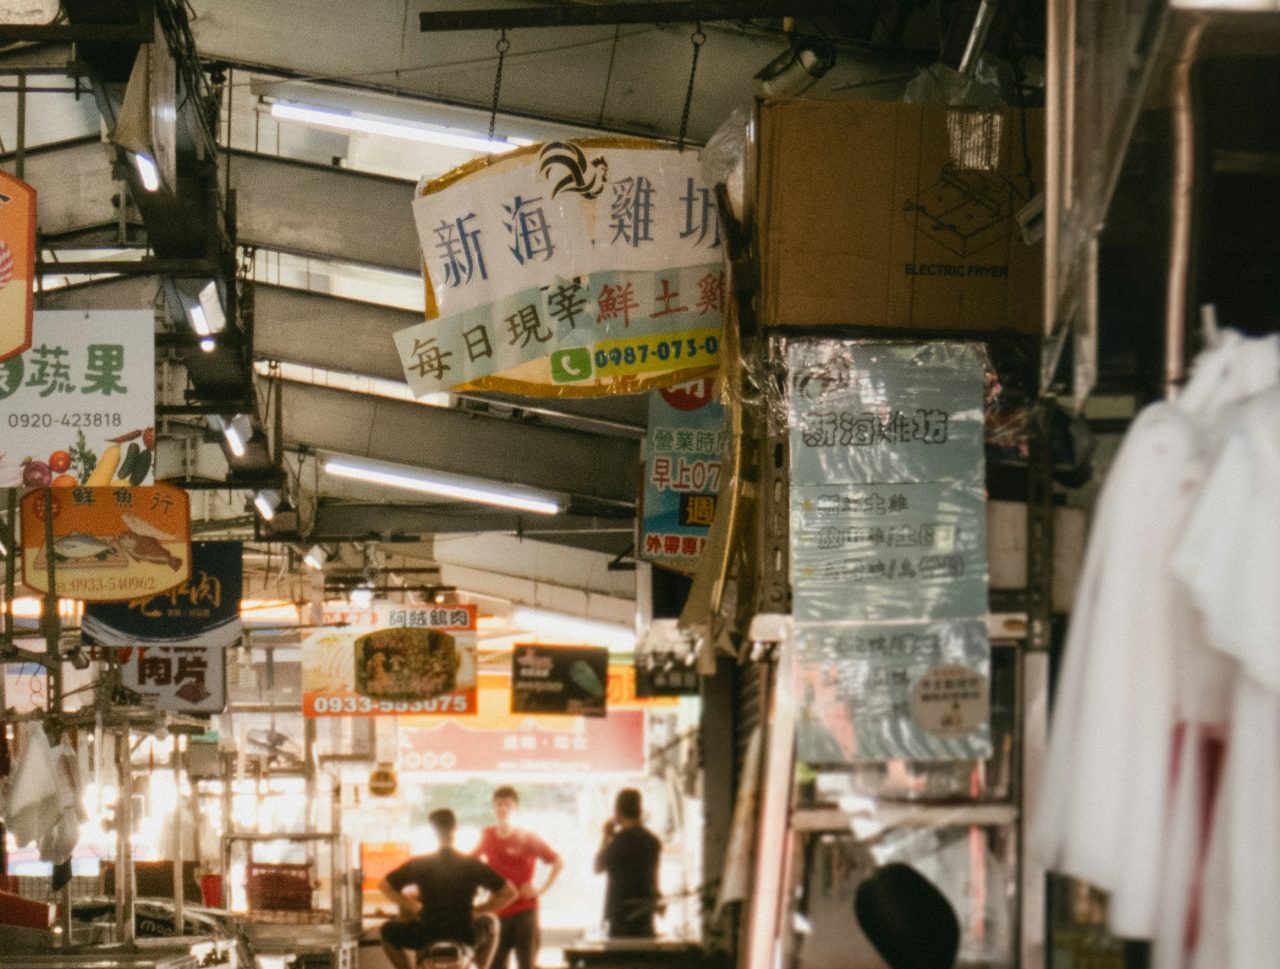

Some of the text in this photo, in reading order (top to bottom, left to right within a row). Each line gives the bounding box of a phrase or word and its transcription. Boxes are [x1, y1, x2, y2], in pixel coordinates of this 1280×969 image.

[905, 263, 1008, 279] ELECTRIC FRYER
[9, 413, 122, 429] 0920-423818
[645, 535, 706, 556] 外帶專
